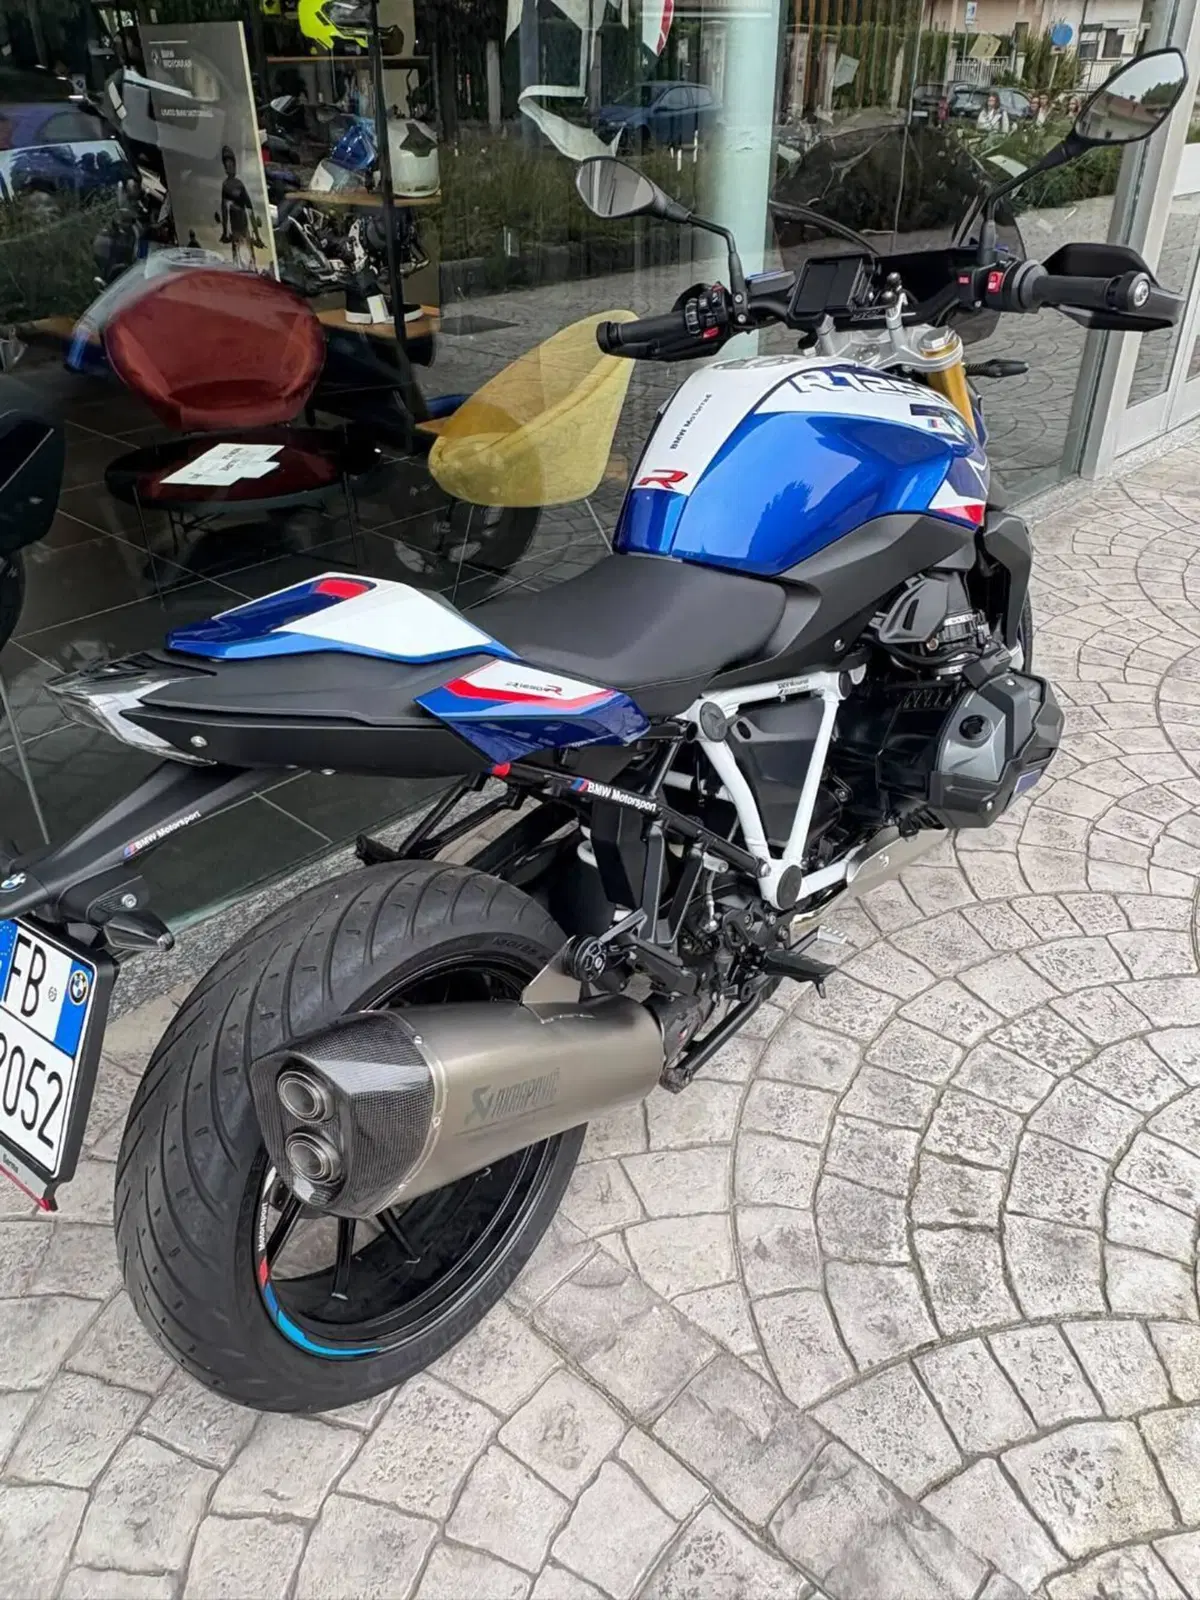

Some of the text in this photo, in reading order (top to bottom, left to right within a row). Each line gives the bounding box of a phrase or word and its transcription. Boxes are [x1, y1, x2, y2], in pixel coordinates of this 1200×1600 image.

[587, 781, 657, 812] BMW Motorsport
[134, 810, 202, 850] BMW Motorsport
[4, 932, 47, 1017] FB
